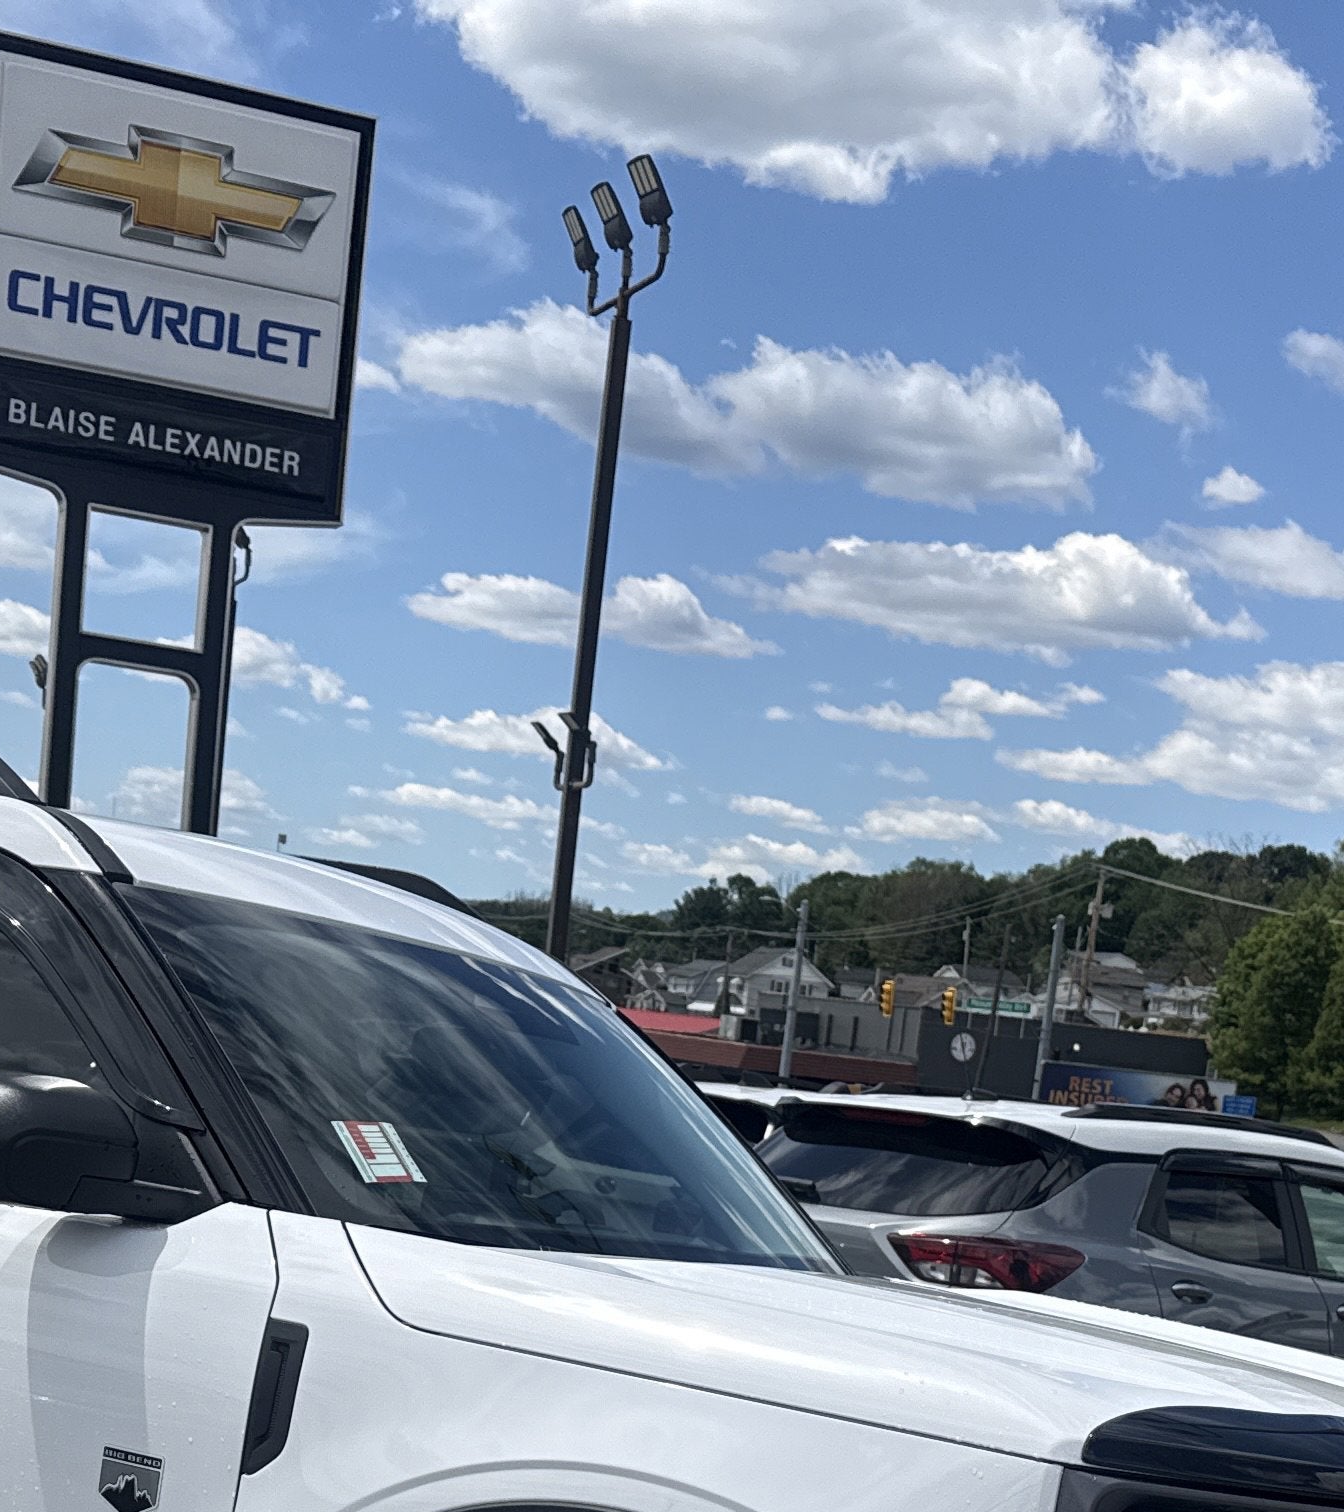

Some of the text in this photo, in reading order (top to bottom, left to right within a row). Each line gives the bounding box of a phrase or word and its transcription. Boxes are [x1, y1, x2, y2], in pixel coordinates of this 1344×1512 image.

[7, 269, 320, 368] CHEVROLET
[8, 398, 301, 477] BLAISE ALEXANDER
[1068, 1076, 1113, 1094] REST
[104, 1449, 161, 1467] BIG BEND
